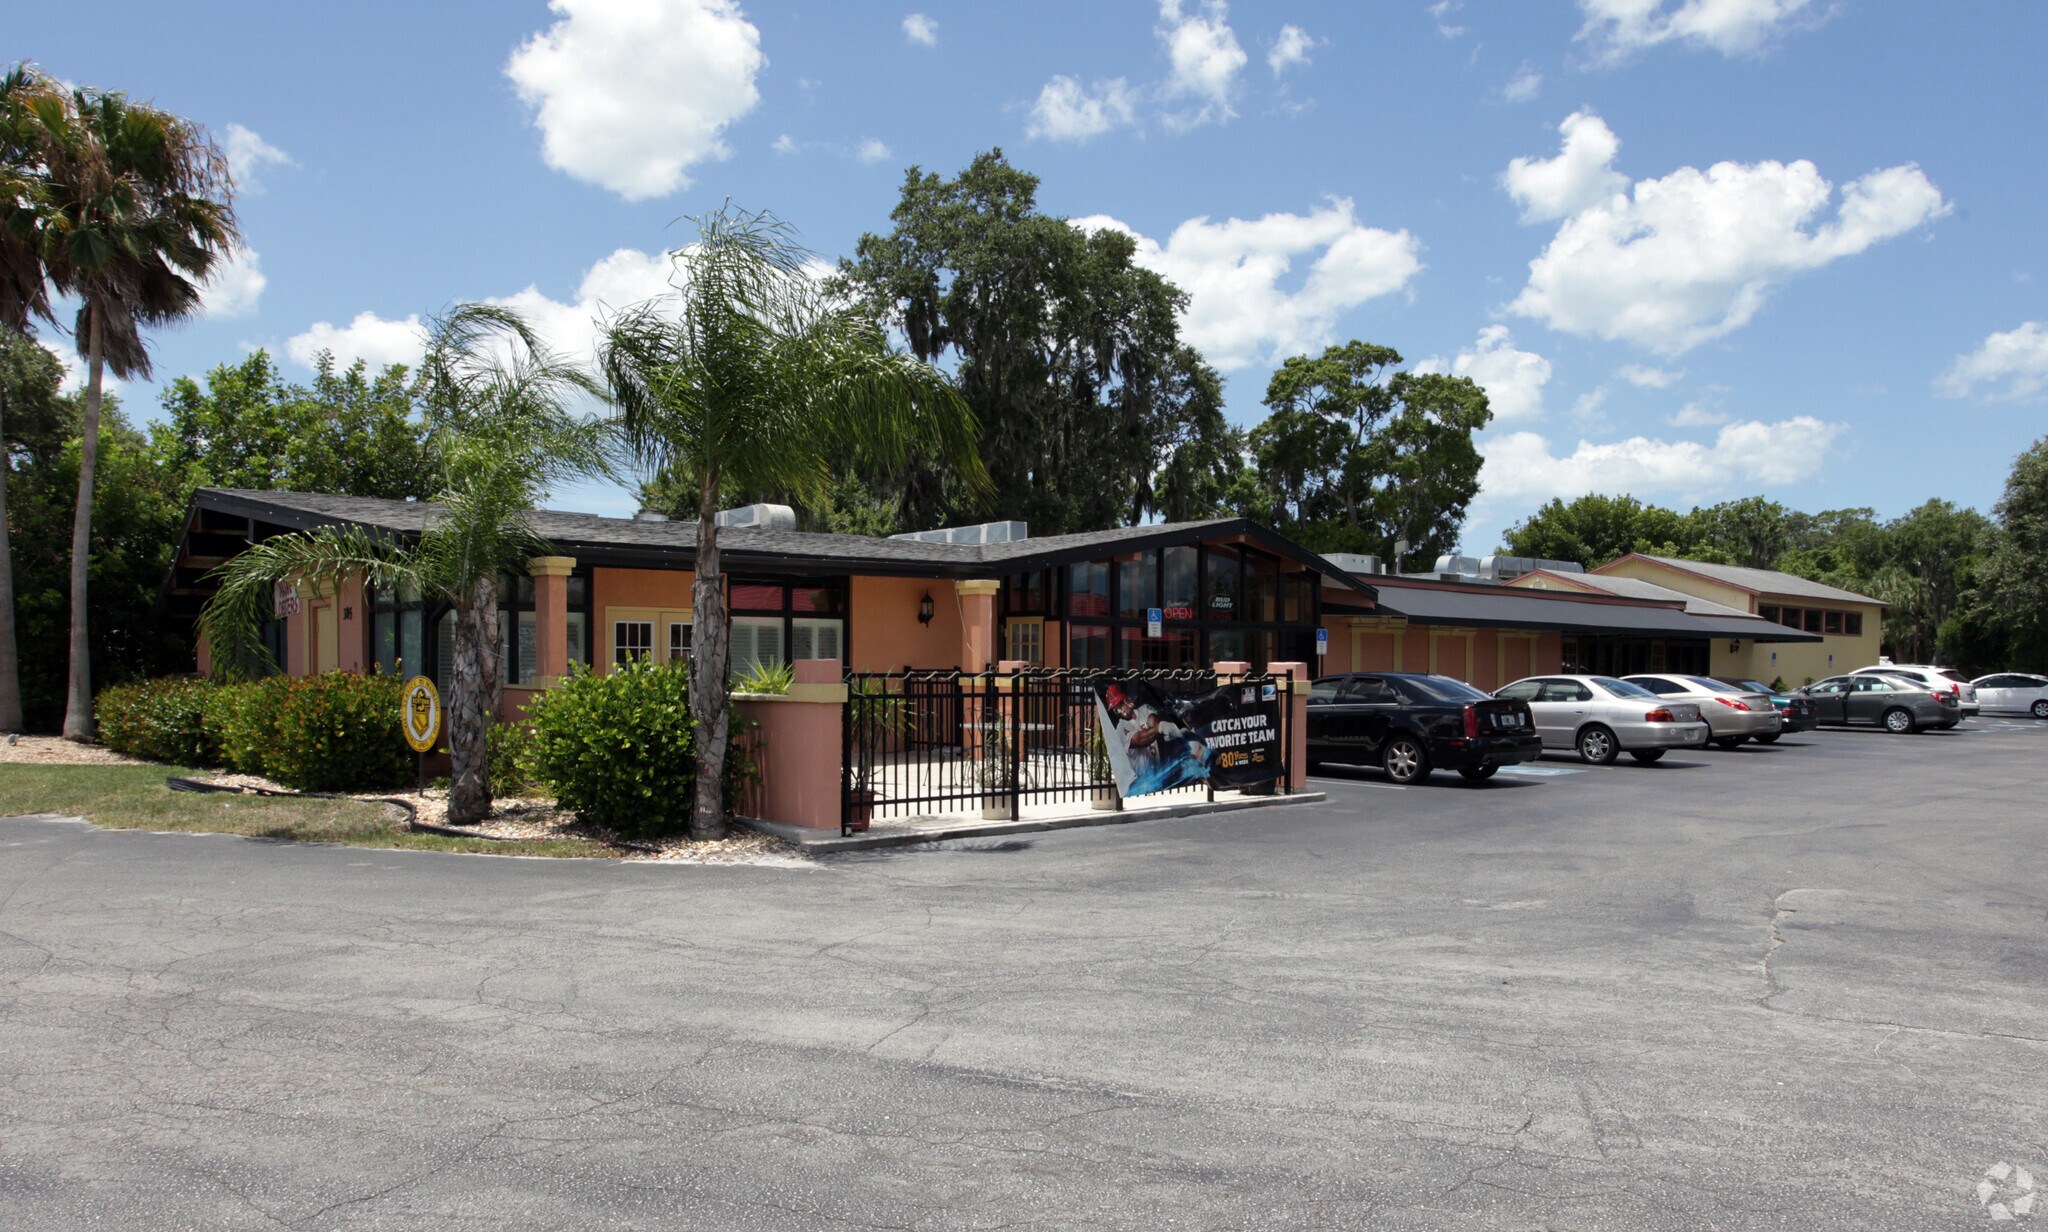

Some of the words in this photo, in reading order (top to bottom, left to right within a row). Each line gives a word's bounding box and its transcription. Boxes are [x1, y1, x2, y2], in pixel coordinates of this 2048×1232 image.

[1164, 607, 1193, 619] OPEN
[1211, 718, 1241, 733] CATCH
[1241, 714, 1267, 729] YOUR
[1205, 732, 1247, 749] FAVORITE
[1248, 728, 1275, 744] TEAM
[1221, 751, 1235, 768] 80
